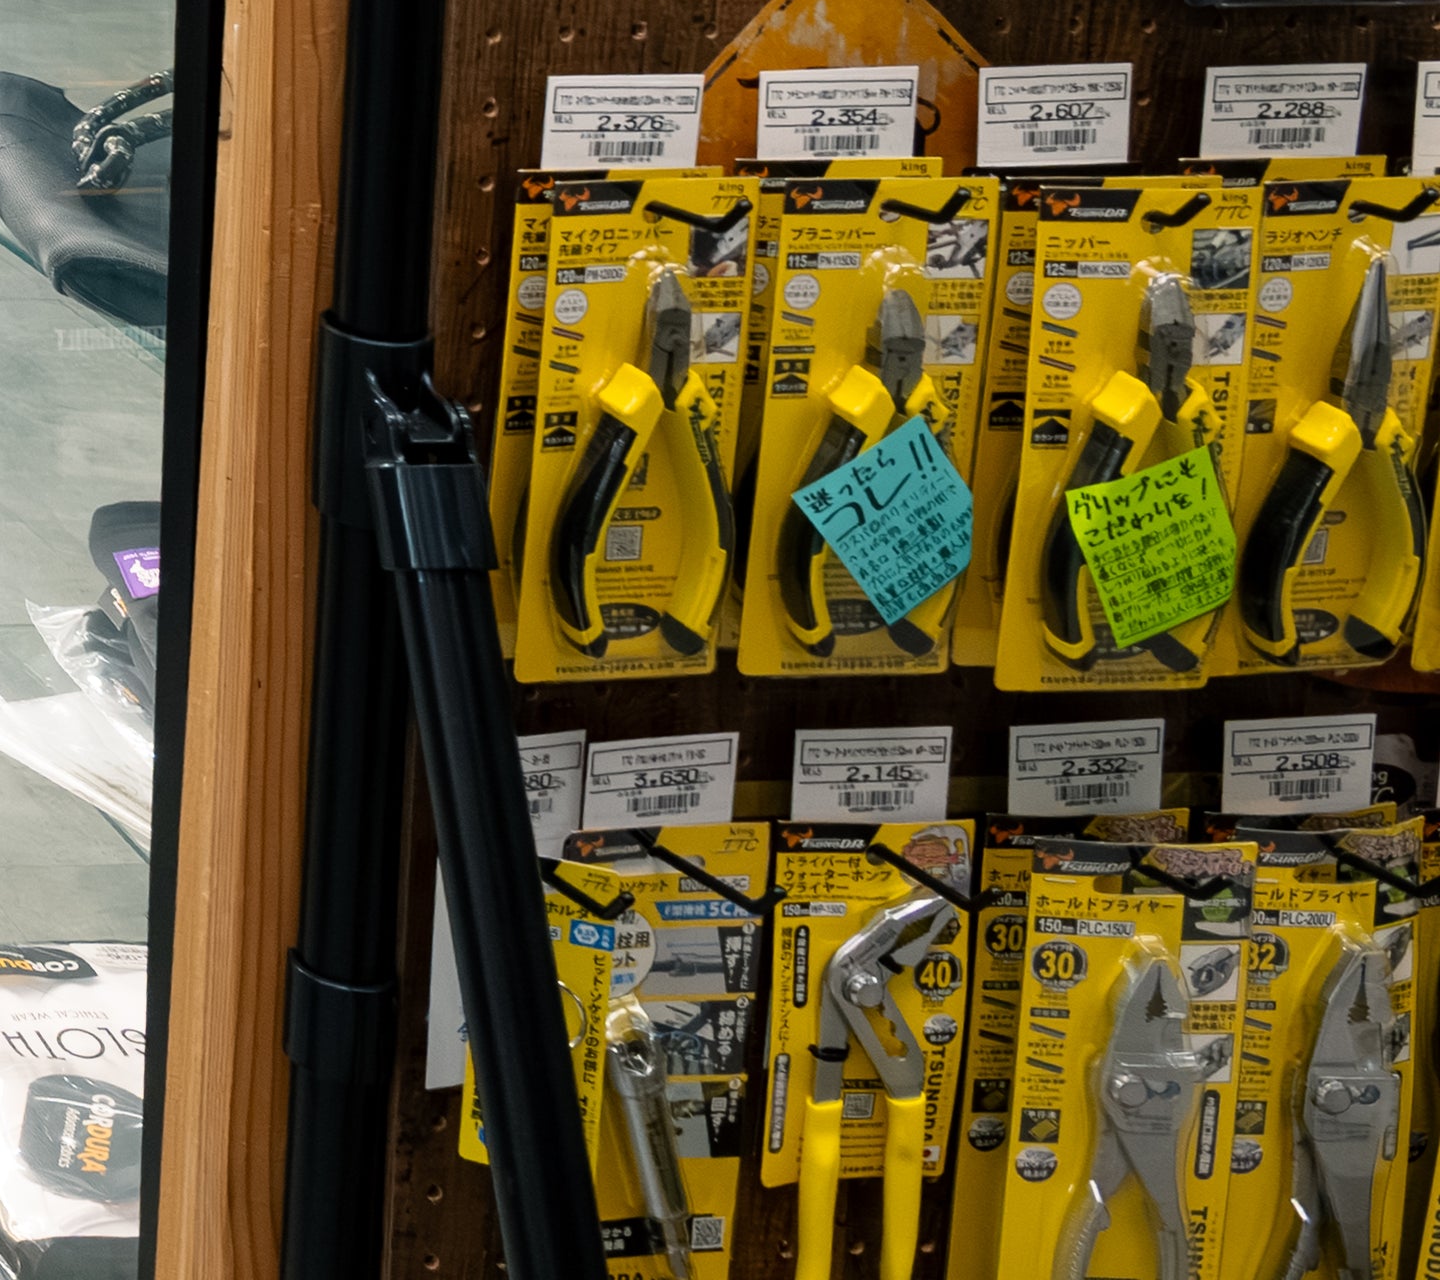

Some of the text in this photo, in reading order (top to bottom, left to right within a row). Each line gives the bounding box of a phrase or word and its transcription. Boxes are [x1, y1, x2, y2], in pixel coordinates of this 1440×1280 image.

[901, 161, 928, 174] king
[1221, 191, 1248, 205] king
[80, 1093, 115, 1174] CORDURA
